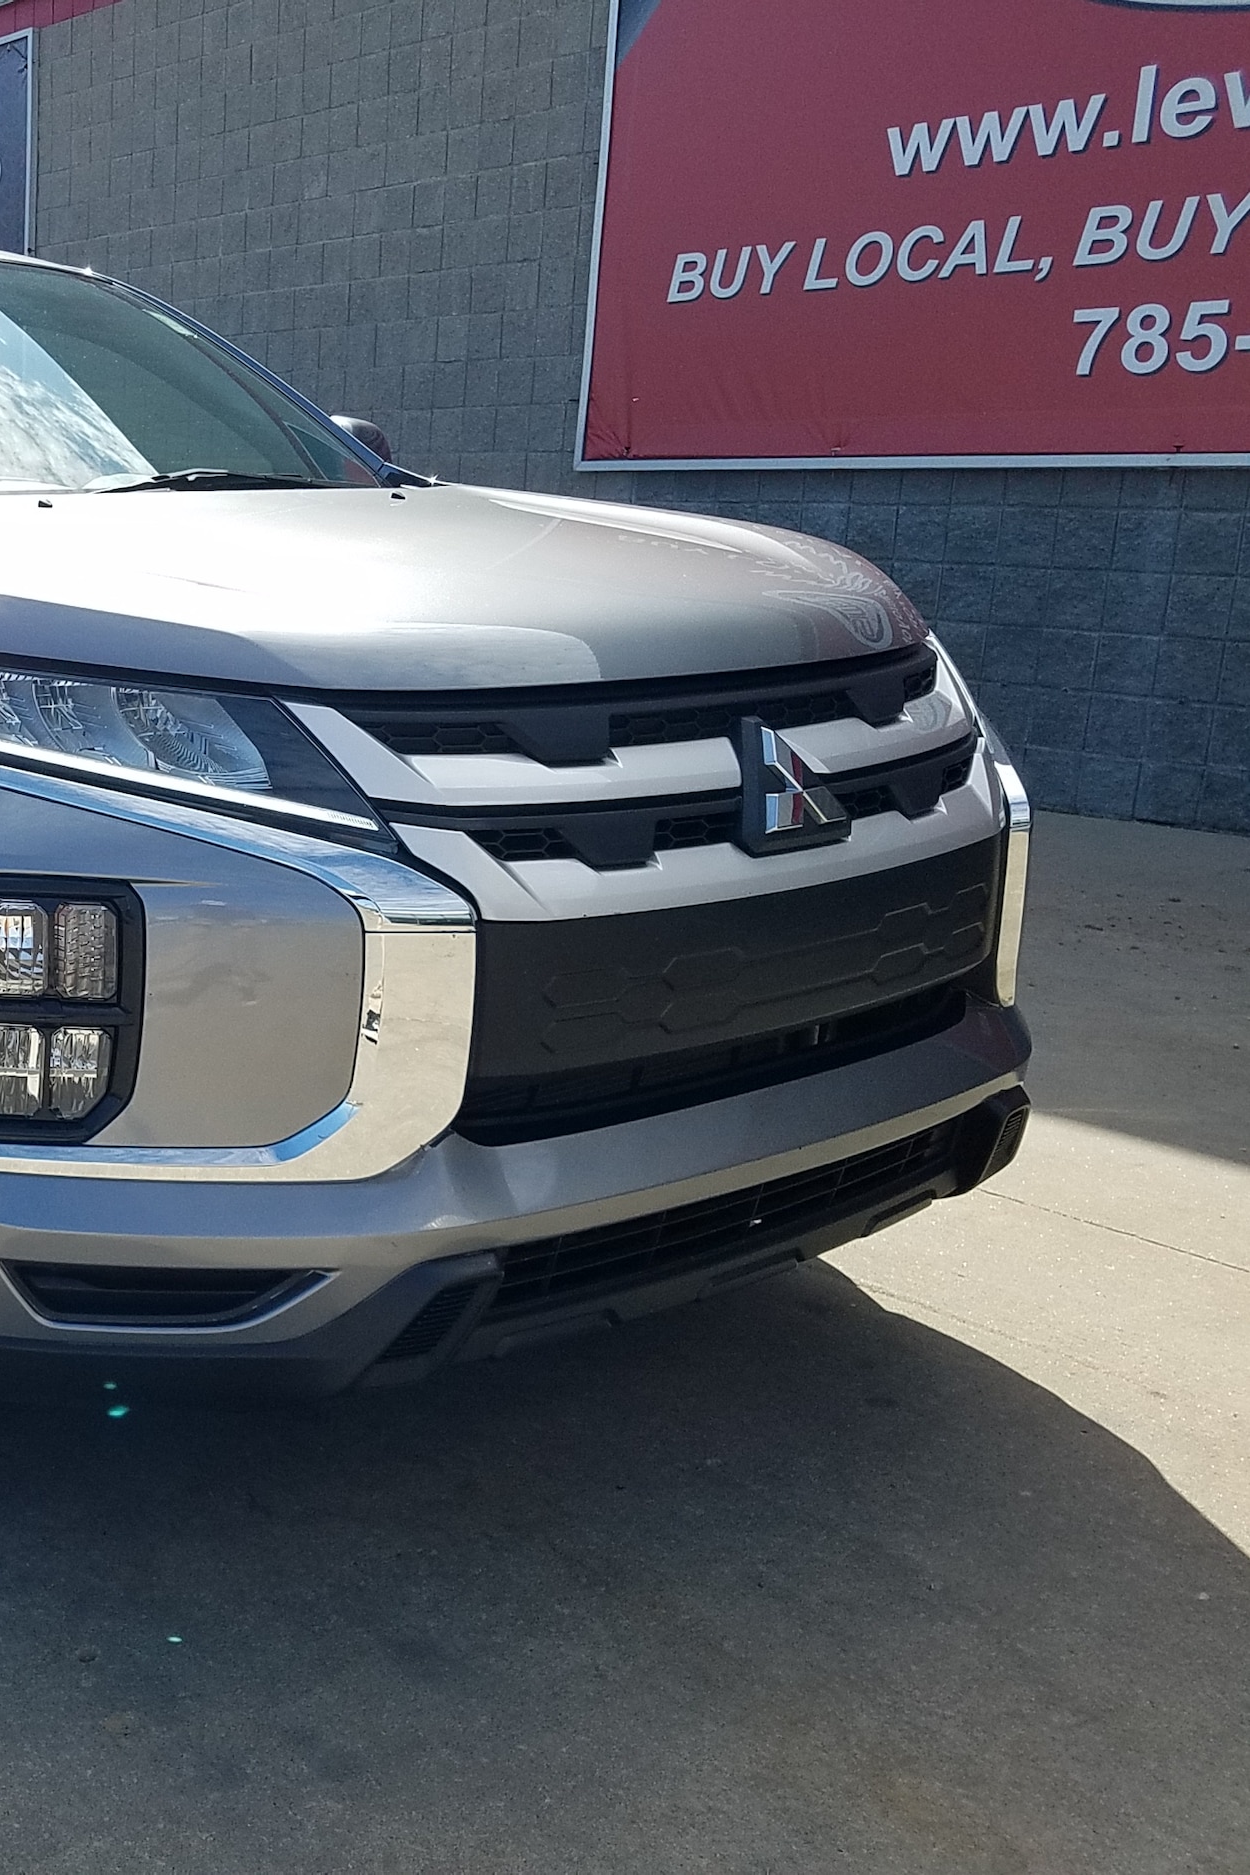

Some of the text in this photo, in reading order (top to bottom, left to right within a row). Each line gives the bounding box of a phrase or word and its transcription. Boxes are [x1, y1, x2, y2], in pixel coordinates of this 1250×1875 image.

[666, 192, 1250, 303] BUY LOCAL, BUY
[1073, 299, 1250, 376] 785-
